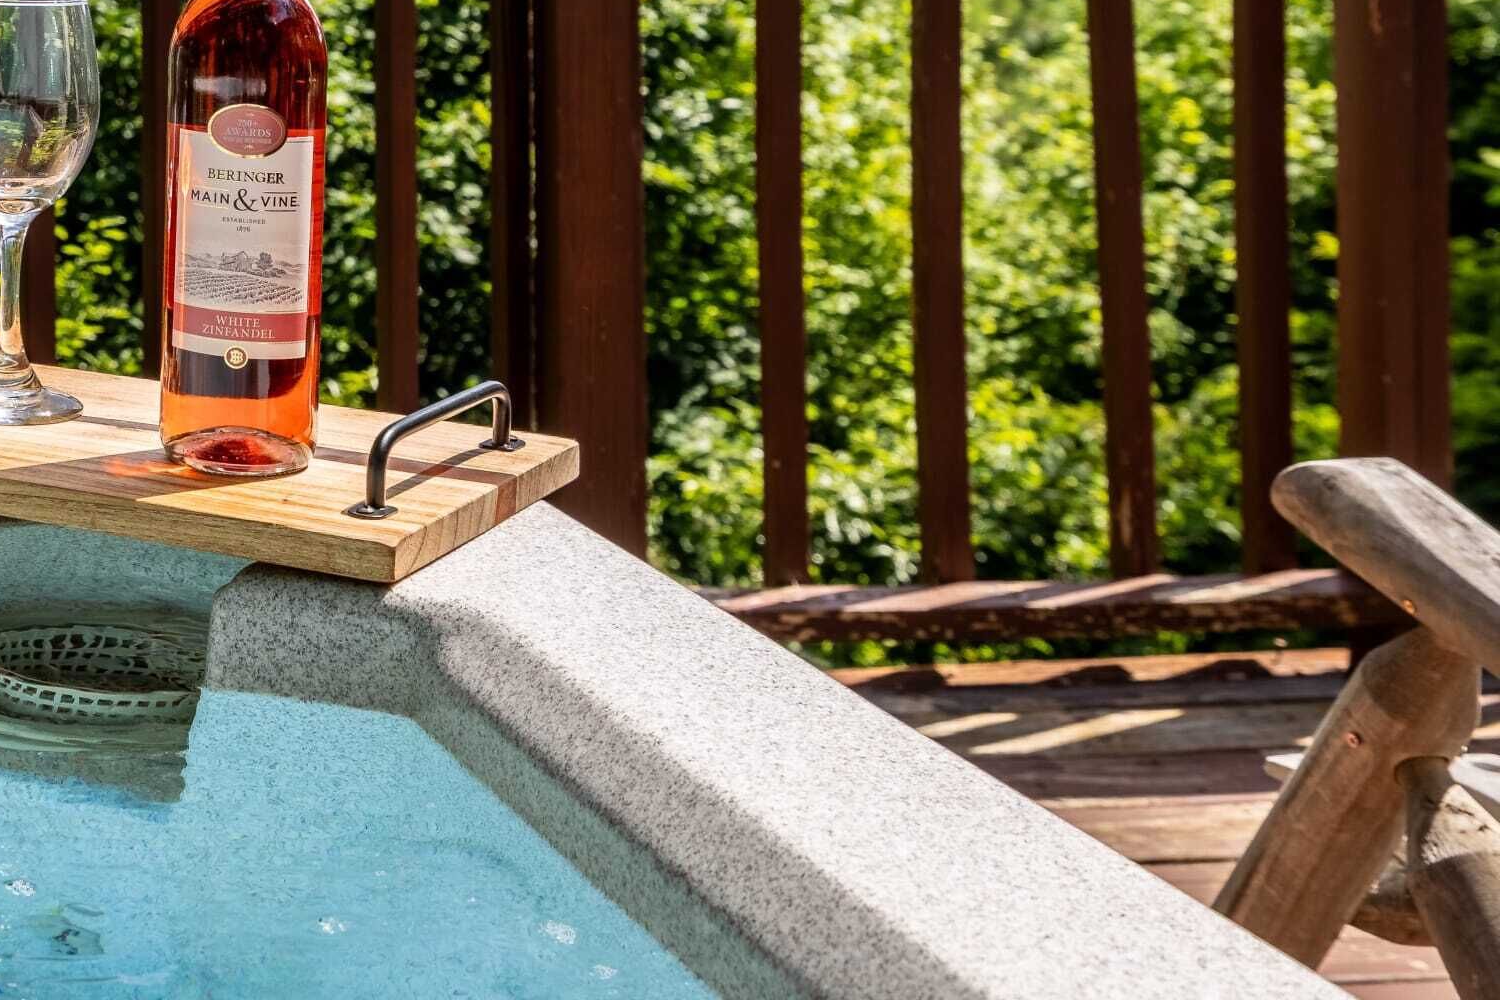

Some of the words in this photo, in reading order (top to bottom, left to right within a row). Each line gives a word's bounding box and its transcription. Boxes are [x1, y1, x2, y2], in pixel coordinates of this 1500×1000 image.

[226, 127, 272, 138] AWARDS
[207, 167, 285, 185] BERINGER
[191, 189, 230, 205] MAIN
[233, 188, 259, 212] &
[260, 196, 299, 208] VINE
[221, 216, 266, 225] ESTABLISHED
[215, 315, 261, 328] WHITE
[201, 323, 275, 339] ZINFANDEL
